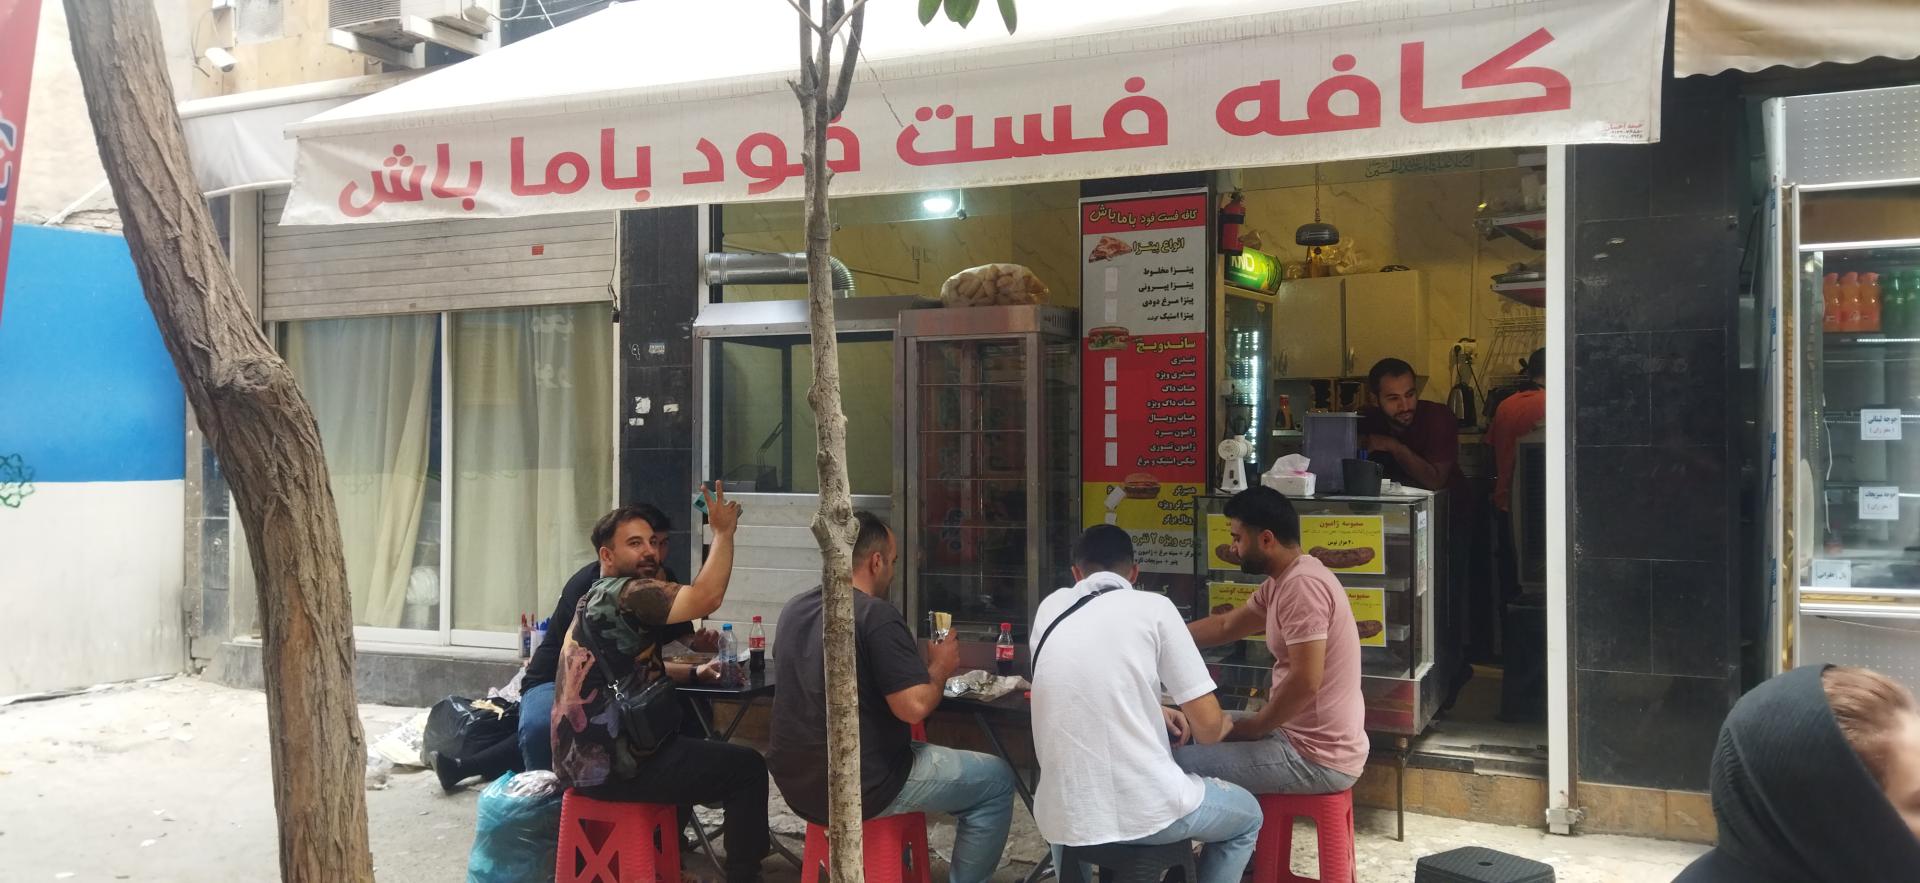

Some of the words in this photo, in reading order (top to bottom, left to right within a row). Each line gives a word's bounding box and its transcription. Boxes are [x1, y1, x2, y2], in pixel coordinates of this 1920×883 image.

[1215, 27, 1572, 137] کافه
[896, 76, 1168, 166] فست
[682, 113, 862, 196] فود
[510, 127, 652, 204] باما
[338, 144, 483, 218] باش
[1158, 210, 1178, 222] فست
[1182, 208, 1198, 220] کافه
[1140, 212, 1155, 226] فود
[1132, 241, 1160, 255] پیتزا
[1161, 237, 1185, 253] انواع
[1144, 267, 1169, 276] مخلوط
[1170, 266, 1194, 275] پیتزا
[1170, 282, 1194, 290] پیتزا
[1142, 299, 1160, 307] دودی
[1162, 297, 1179, 306] مرغ
[1180, 296, 1194, 305] پیتزا
[1160, 312, 1179, 321] استیک
[1180, 312, 1194, 320] پیتزا
[1136, 336, 1196, 353] ساندویچ
[1170, 356, 1196, 365] بندری
[1156, 371, 1170, 380] ویژه
[1170, 371, 1196, 379] بندری
[1147, 400, 1161, 408] ویژه
[1149, 414, 1176, 423] رویال
[1150, 443, 1174, 452] تنوری
[1137, 456, 1150, 466] مرغ
[1176, 457, 1196, 466] میکس
[1173, 486, 1196, 496] همبرگر
[1158, 500, 1173, 510] ویژه
[1320, 520, 1340, 528] ژامبون
[1132, 533, 1150, 546] نفره
[1158, 534, 1178, 547] ویژه
